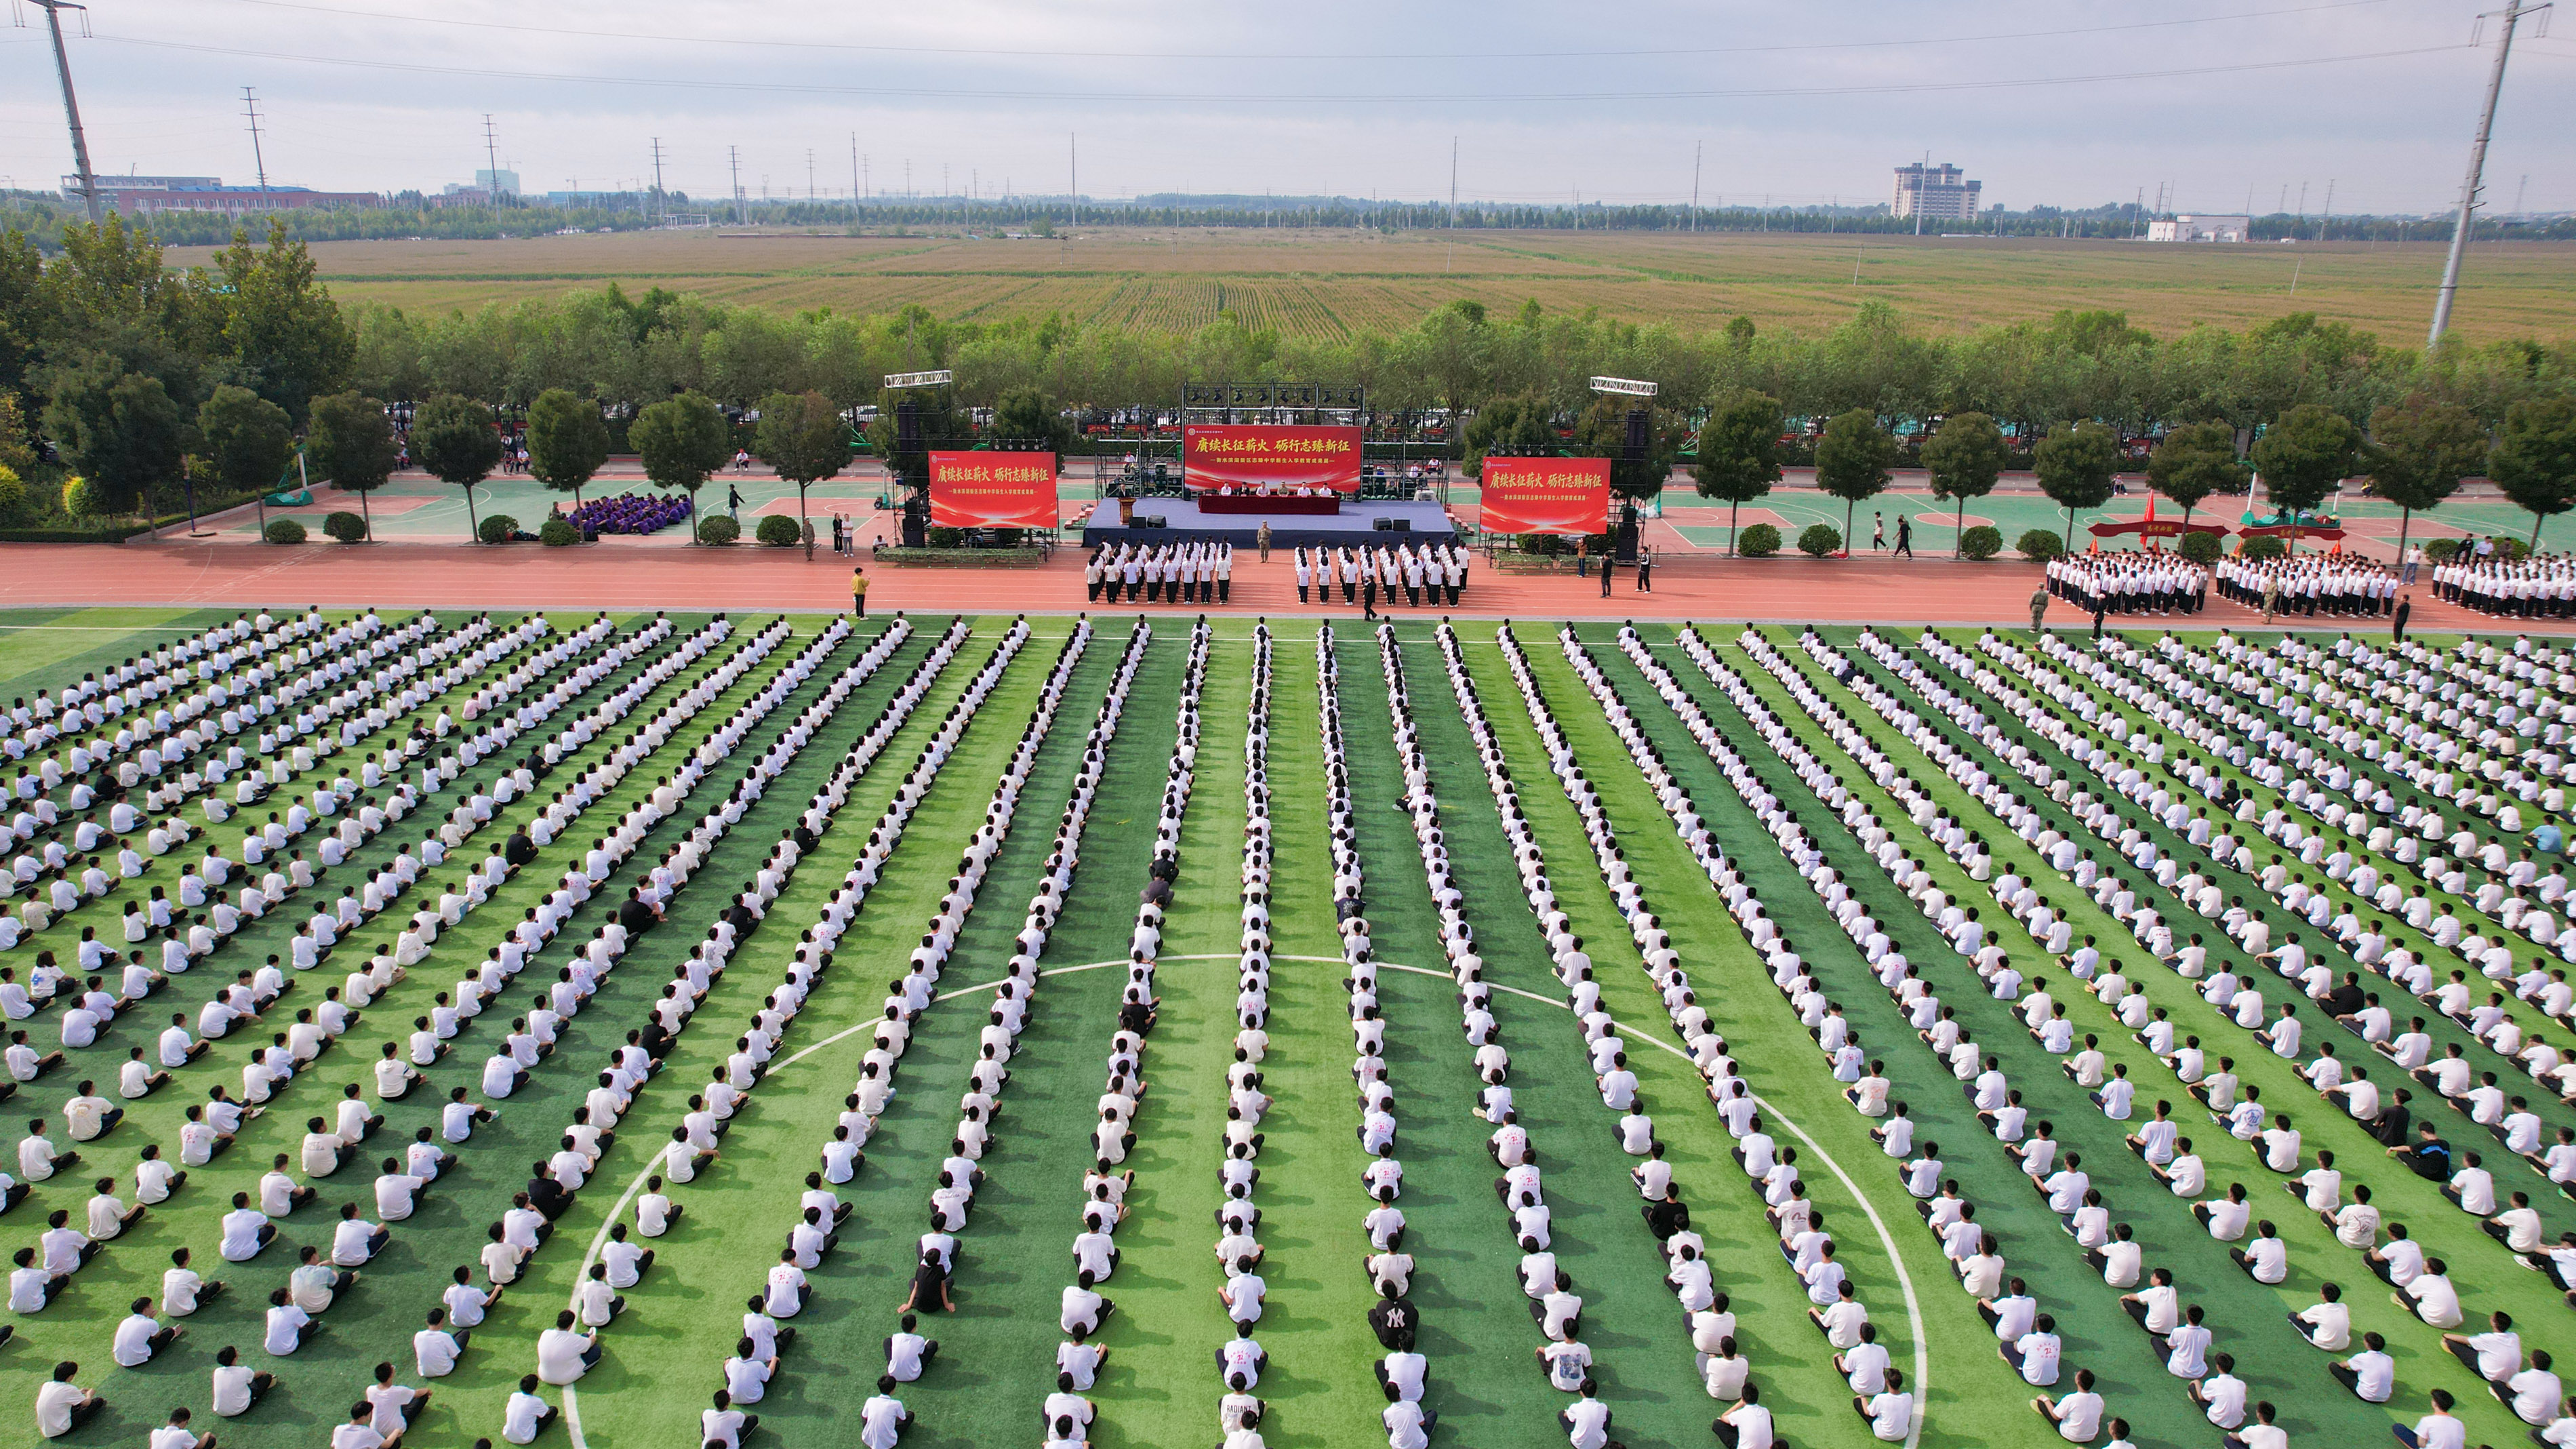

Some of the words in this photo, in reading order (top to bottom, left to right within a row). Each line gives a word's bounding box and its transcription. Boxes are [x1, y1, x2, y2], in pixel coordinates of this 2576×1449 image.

[1195, 437, 1271, 454] 赓续长征薪火
[1273, 438, 1351, 454] 砺行志臻新征
[937, 465, 991, 483] 赓续长征薪火
[994, 466, 1049, 483] 砺行志臻新征
[1489, 471, 1544, 489] 赓续长征薪火
[1546, 473, 1602, 490] 砺行志臻新征
[1386, 1307, 1405, 1328] NY
[1226, 1404, 1252, 1414] RADIANT
